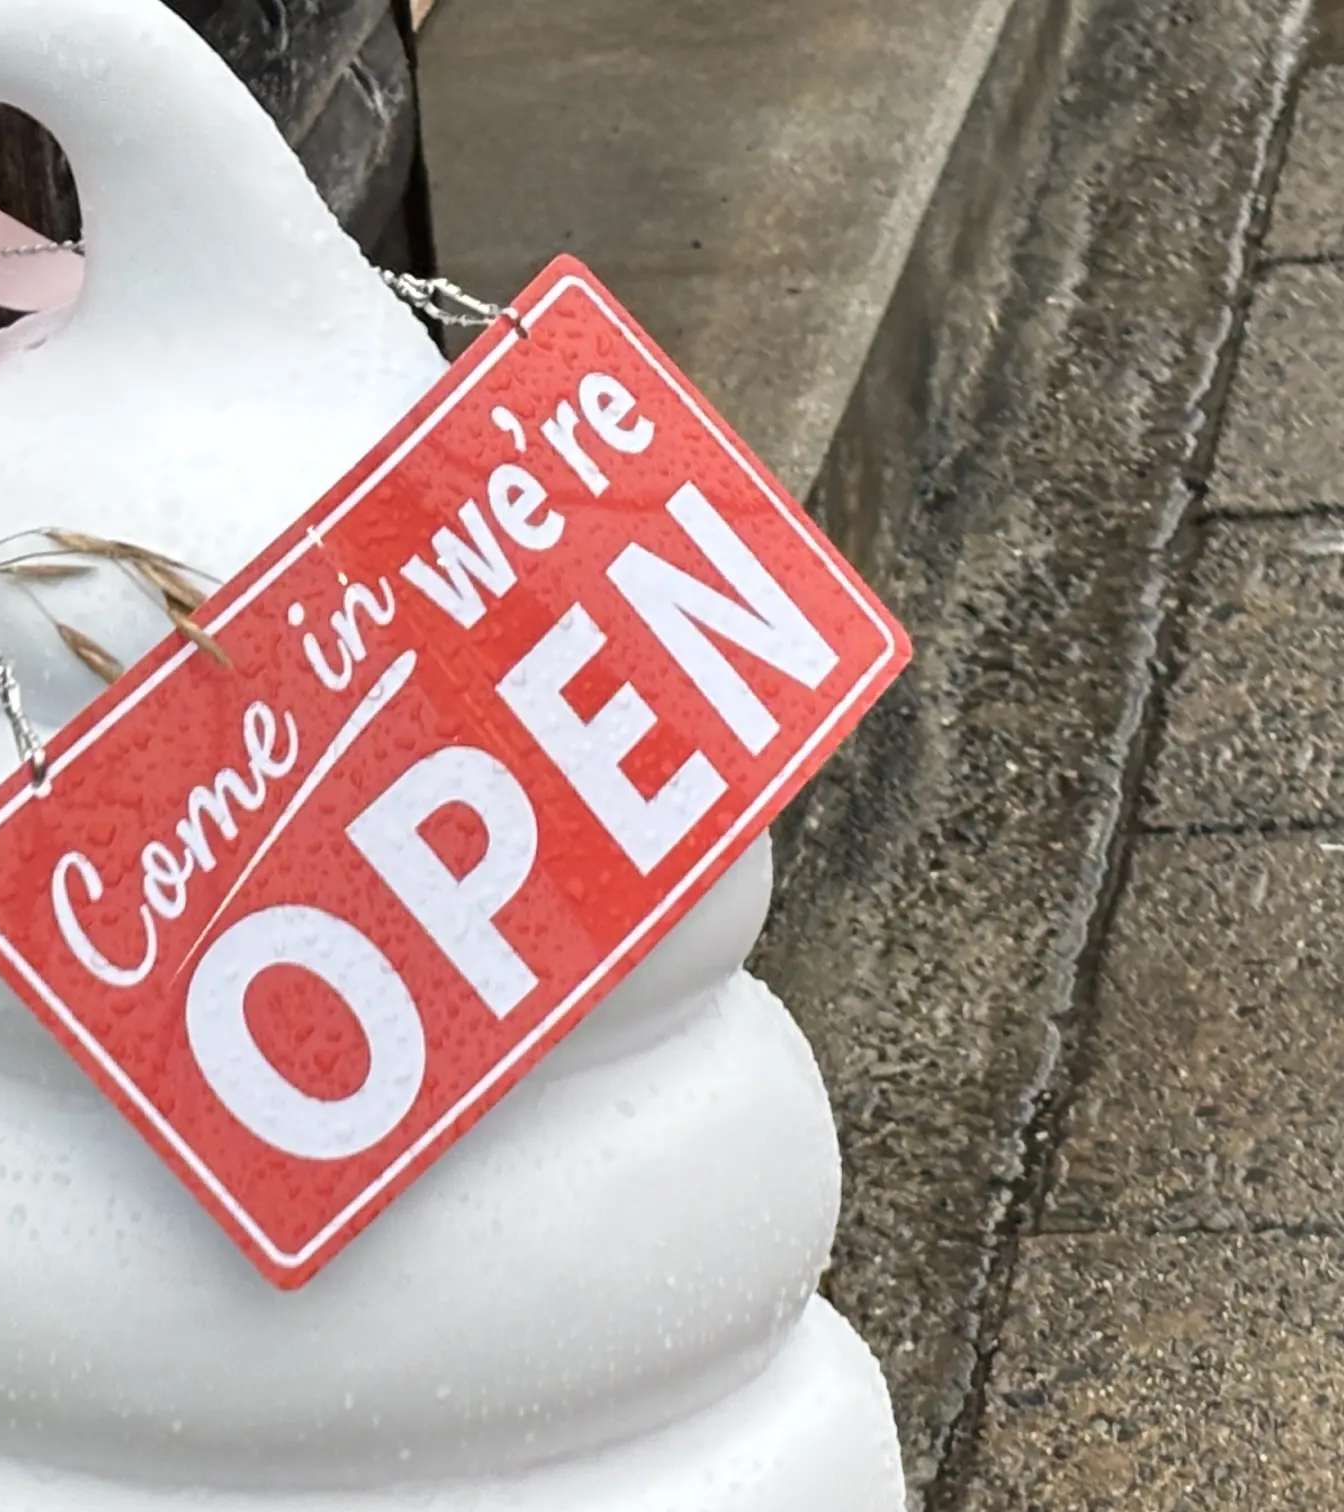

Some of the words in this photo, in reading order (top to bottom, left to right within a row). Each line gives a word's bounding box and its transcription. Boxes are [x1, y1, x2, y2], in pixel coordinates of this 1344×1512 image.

[51, 700, 299, 987] Come
[288, 577, 395, 691] in
[400, 371, 656, 630] we're
[185, 481, 840, 1161] OPEN
